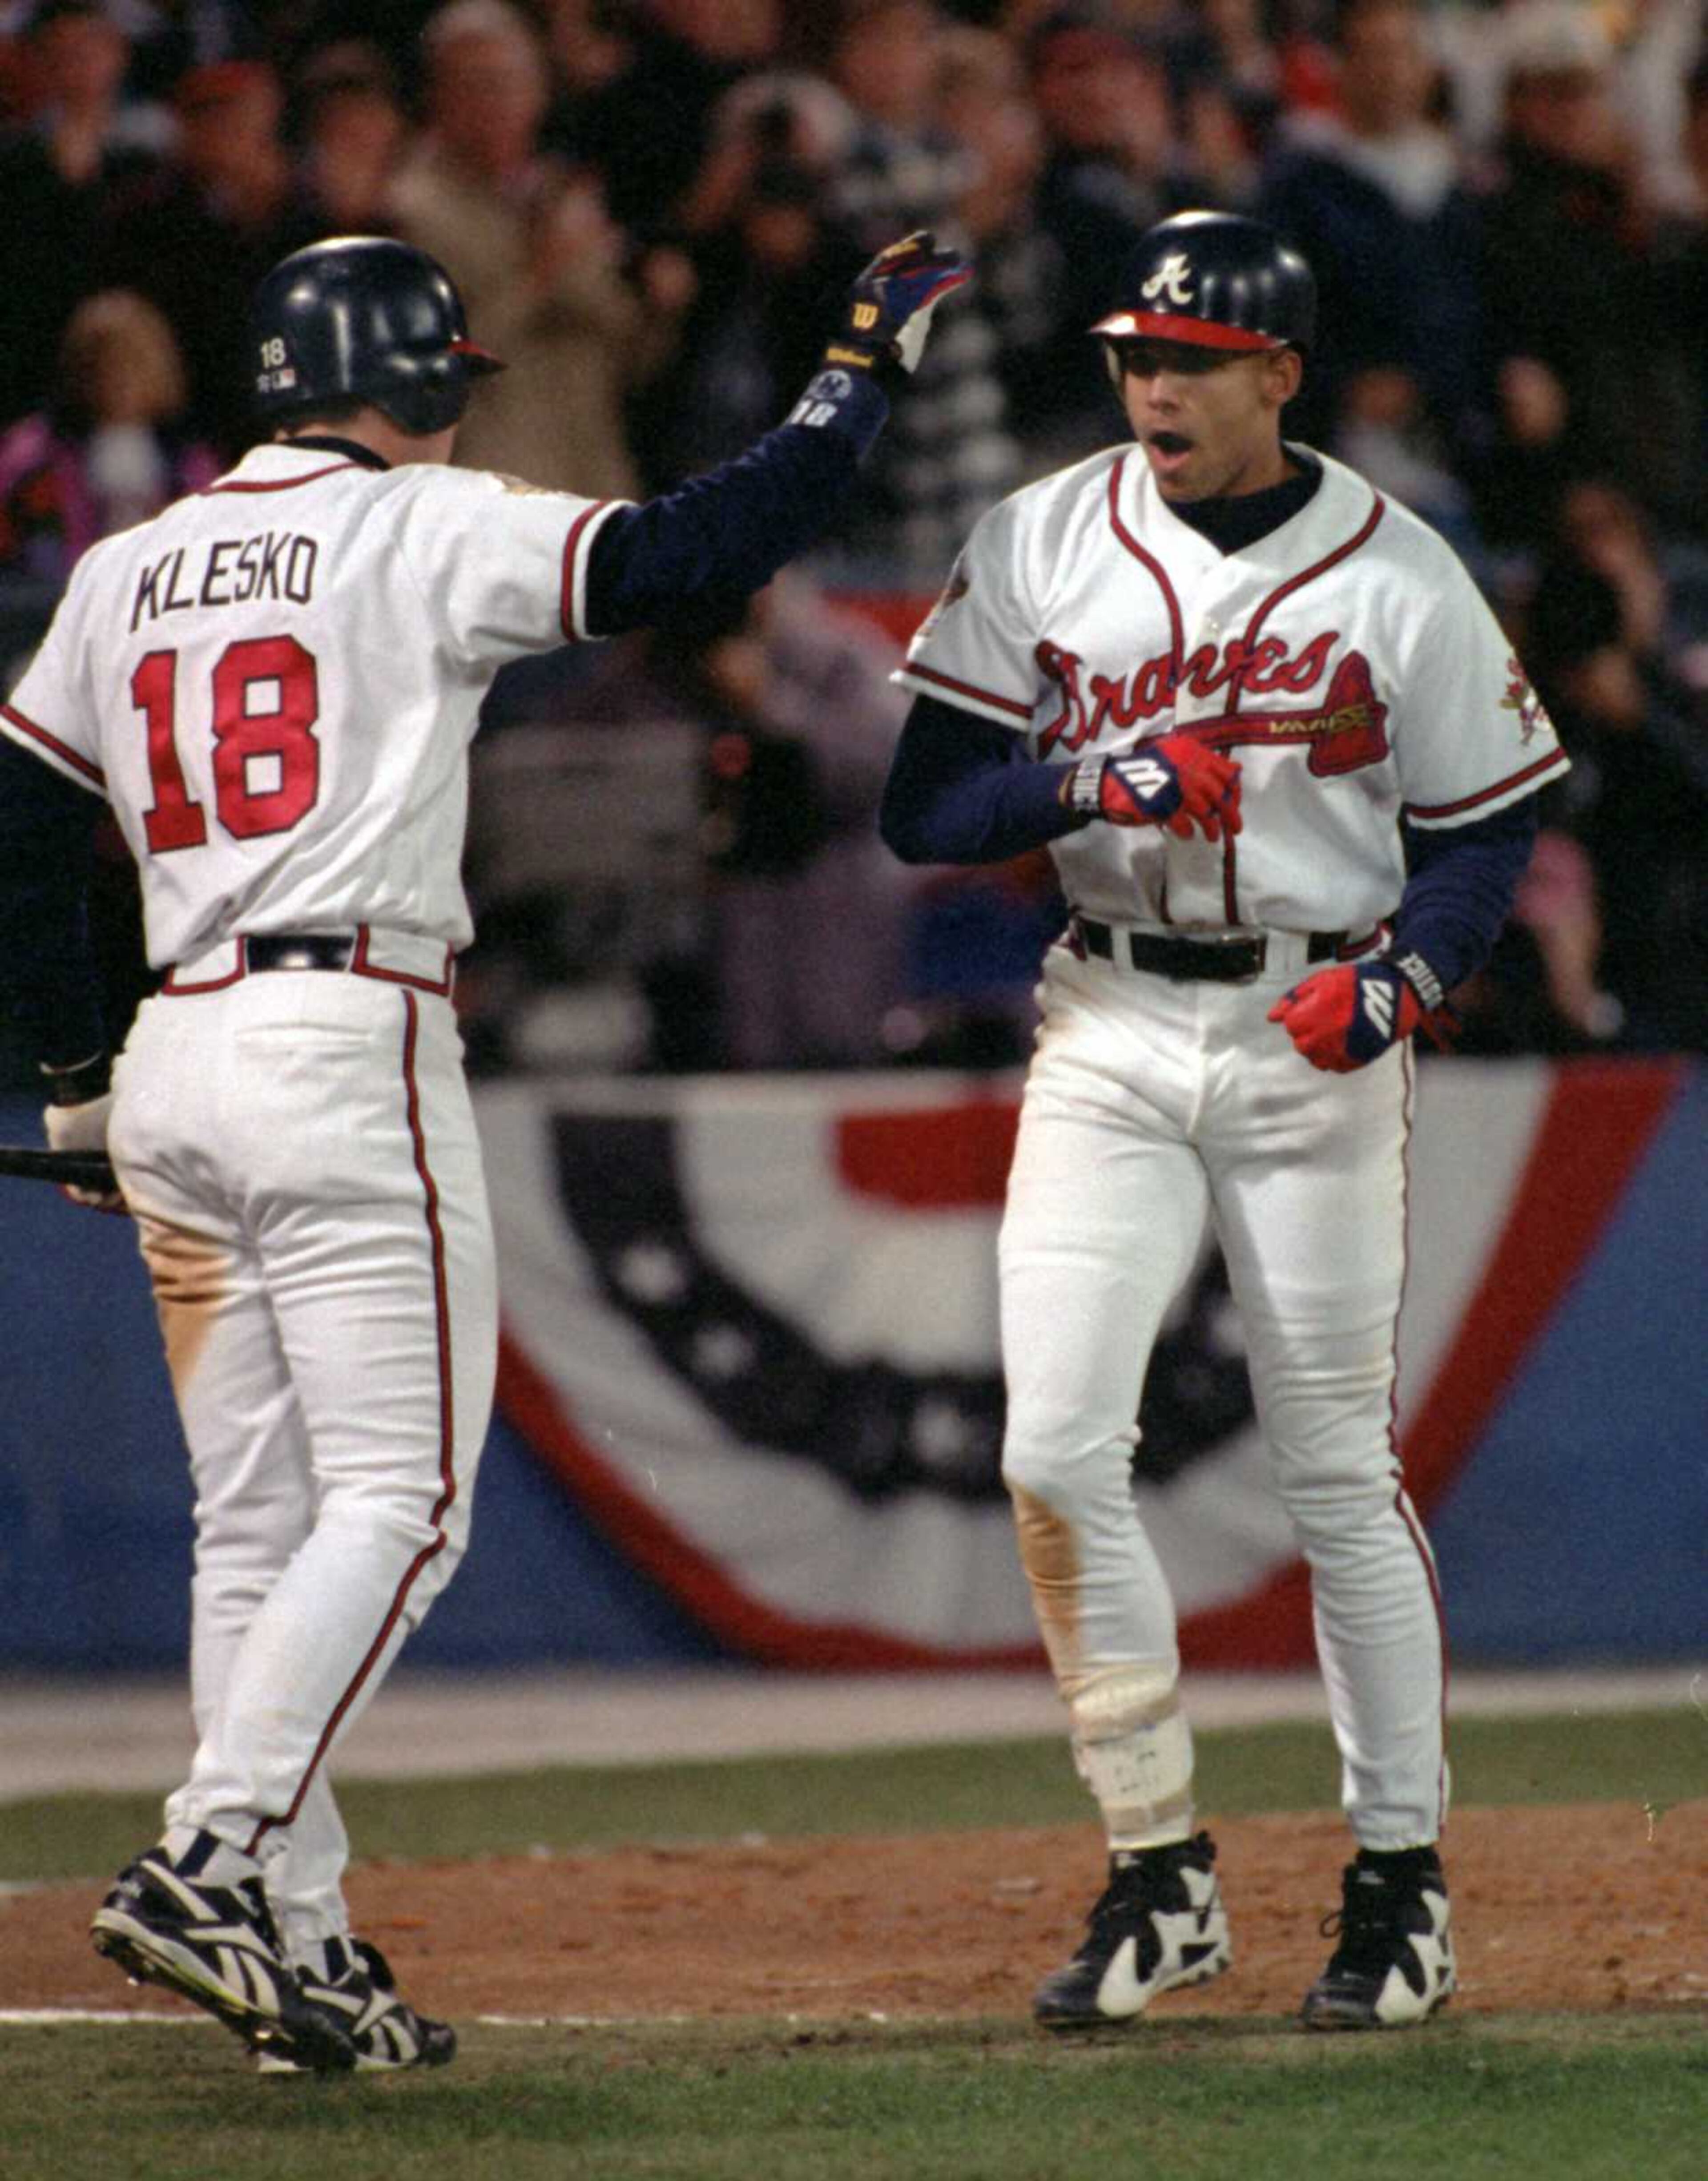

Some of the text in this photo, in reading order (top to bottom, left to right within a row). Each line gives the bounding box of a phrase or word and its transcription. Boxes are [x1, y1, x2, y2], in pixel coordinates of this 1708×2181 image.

[1141, 253, 1194, 305] A
[261, 337, 286, 369] 18
[129, 531, 317, 633] KLESKO
[130, 633, 320, 854] 18
[1035, 631, 1340, 761] Braves
